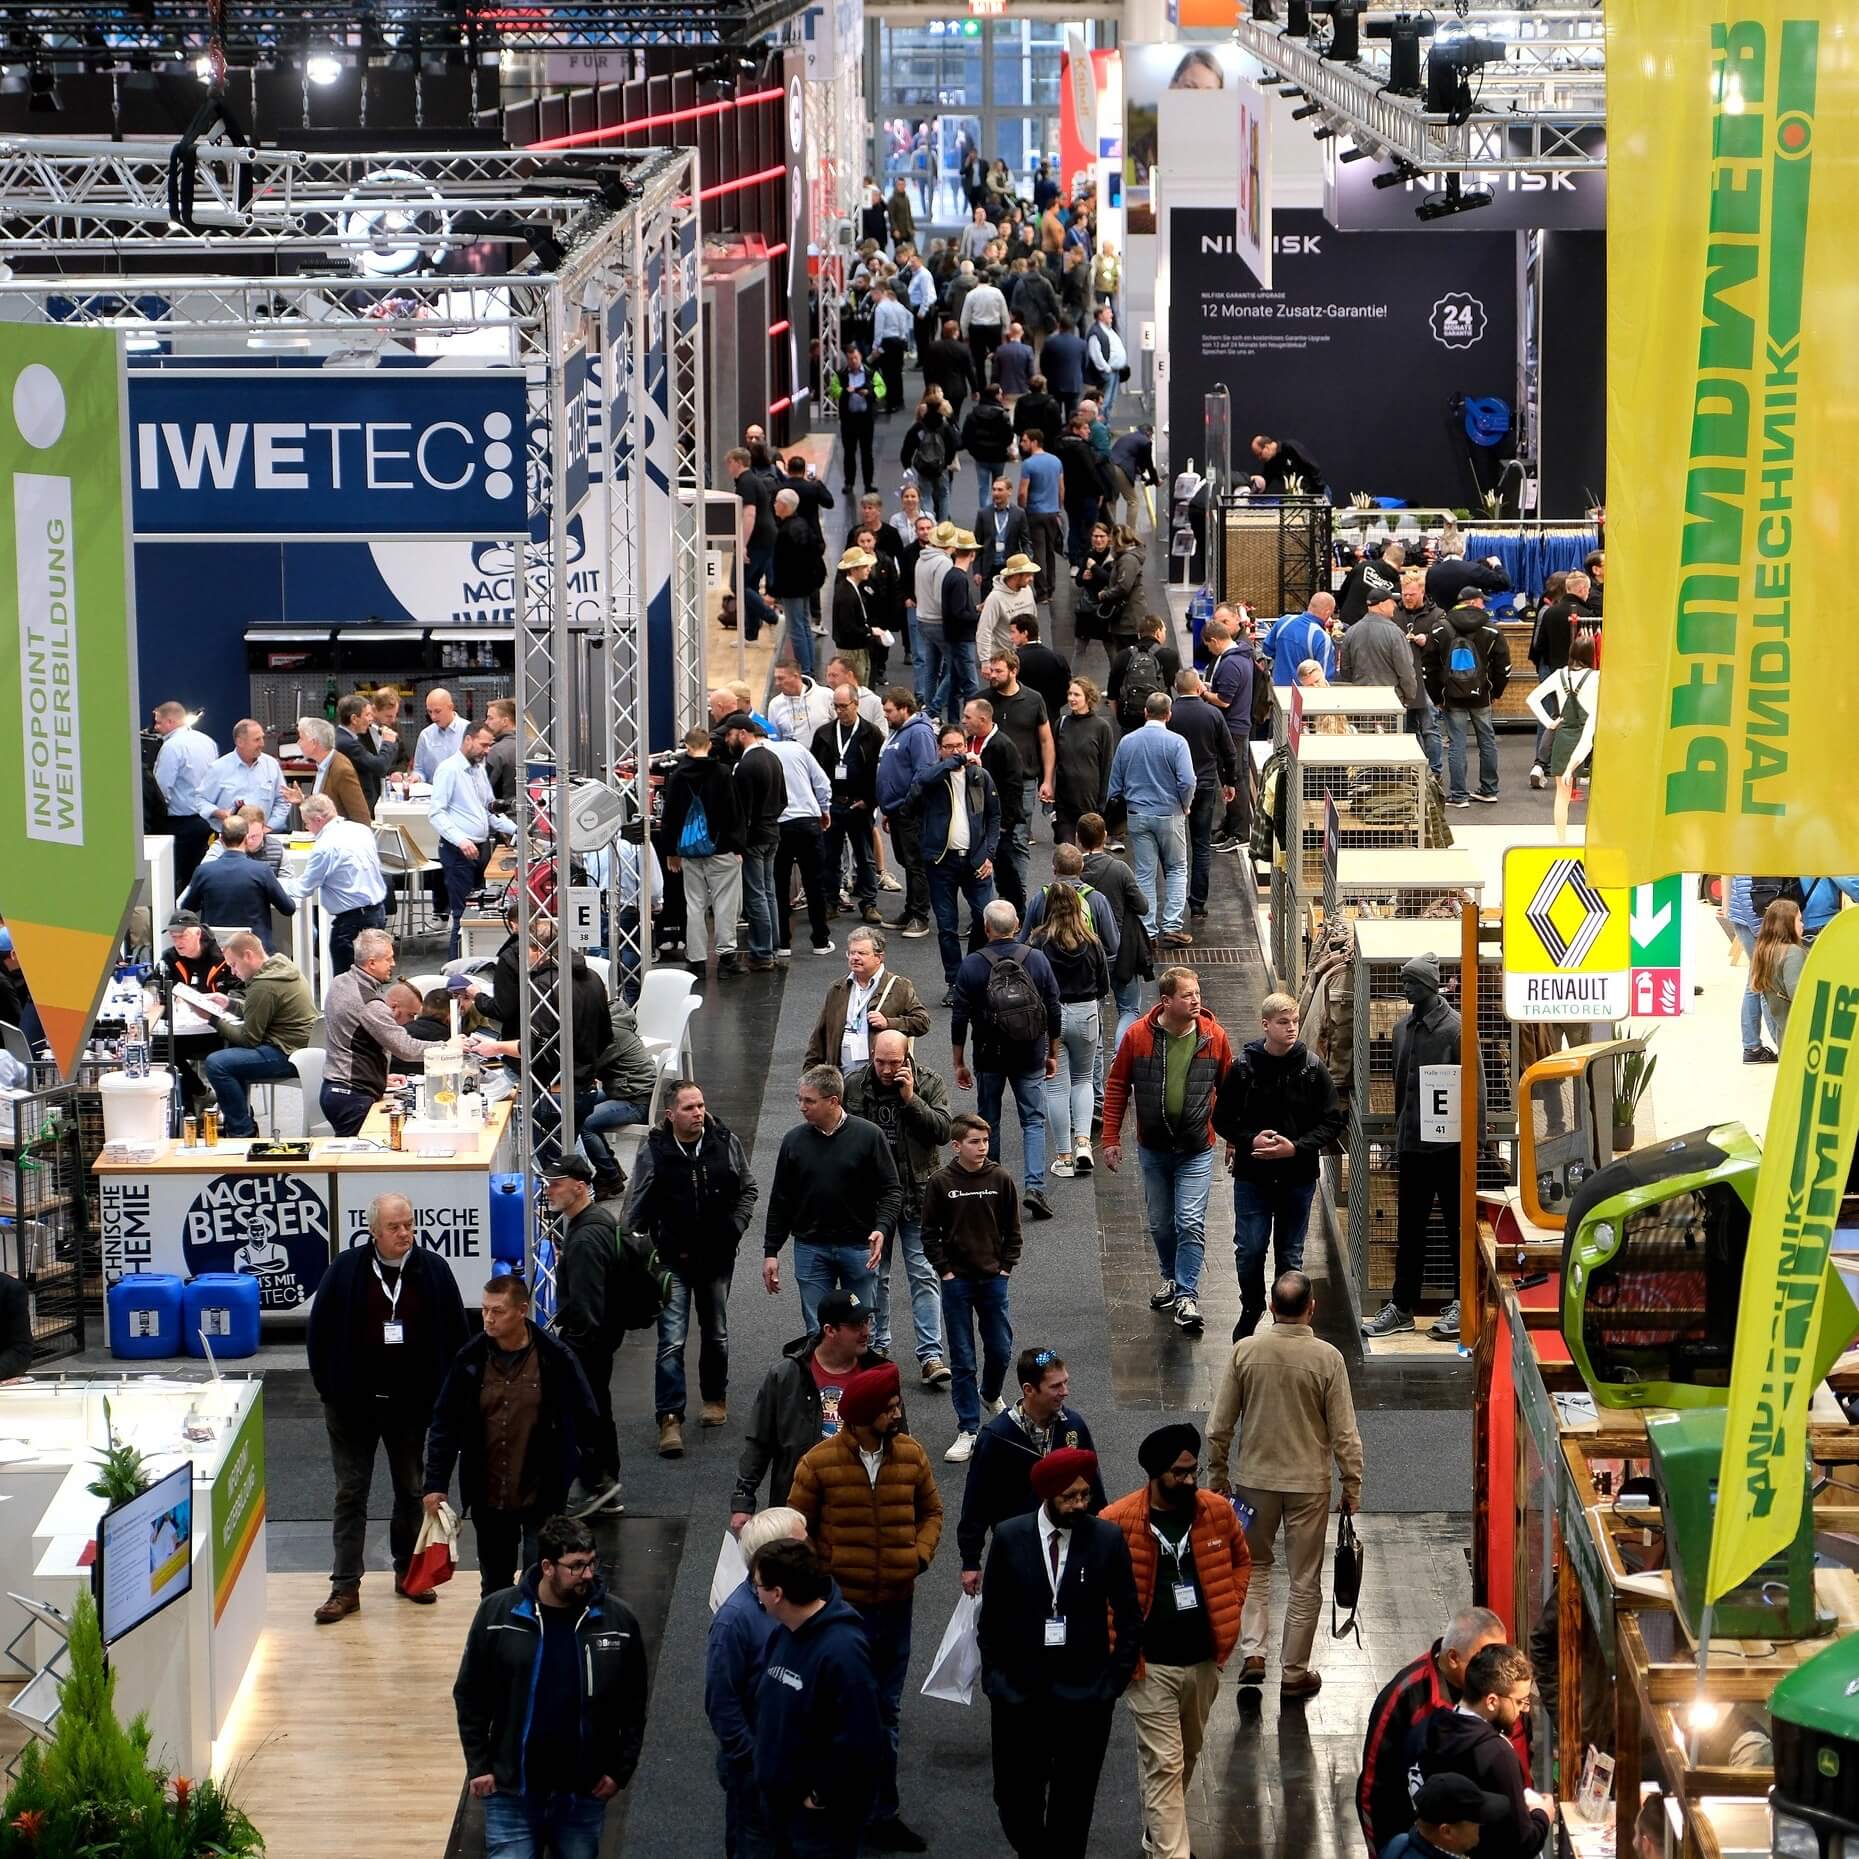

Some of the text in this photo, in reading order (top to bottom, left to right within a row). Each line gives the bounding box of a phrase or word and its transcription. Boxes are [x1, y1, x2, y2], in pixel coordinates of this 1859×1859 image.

[1201, 235, 1322, 254] NIISK
[1202, 304, 1388, 318] 12 Monate Zusatz-Garantie!
[1443, 305, 1474, 324] 24
[1158, 360, 1165, 371] E
[138, 422, 475, 490] IWETEC
[707, 562, 715, 576] E
[47, 518, 75, 831] WEITERBILDUNG
[27, 625, 52, 828] INFOPOINT
[578, 905, 590, 926] E
[1528, 977, 1609, 1001] RENAULT
[1522, 1004, 1612, 1016] TRAKTOREN
[1433, 1089, 1449, 1115] E
[1435, 1125, 1446, 1134] 41
[947, 1188, 999, 1199] Champion
[122, 1184, 151, 1275] HEMIE
[188, 1200, 329, 1245] BESSER
[103, 1185, 123, 1283] CHNISCHE
[274, 1273, 297, 1287] MIT
